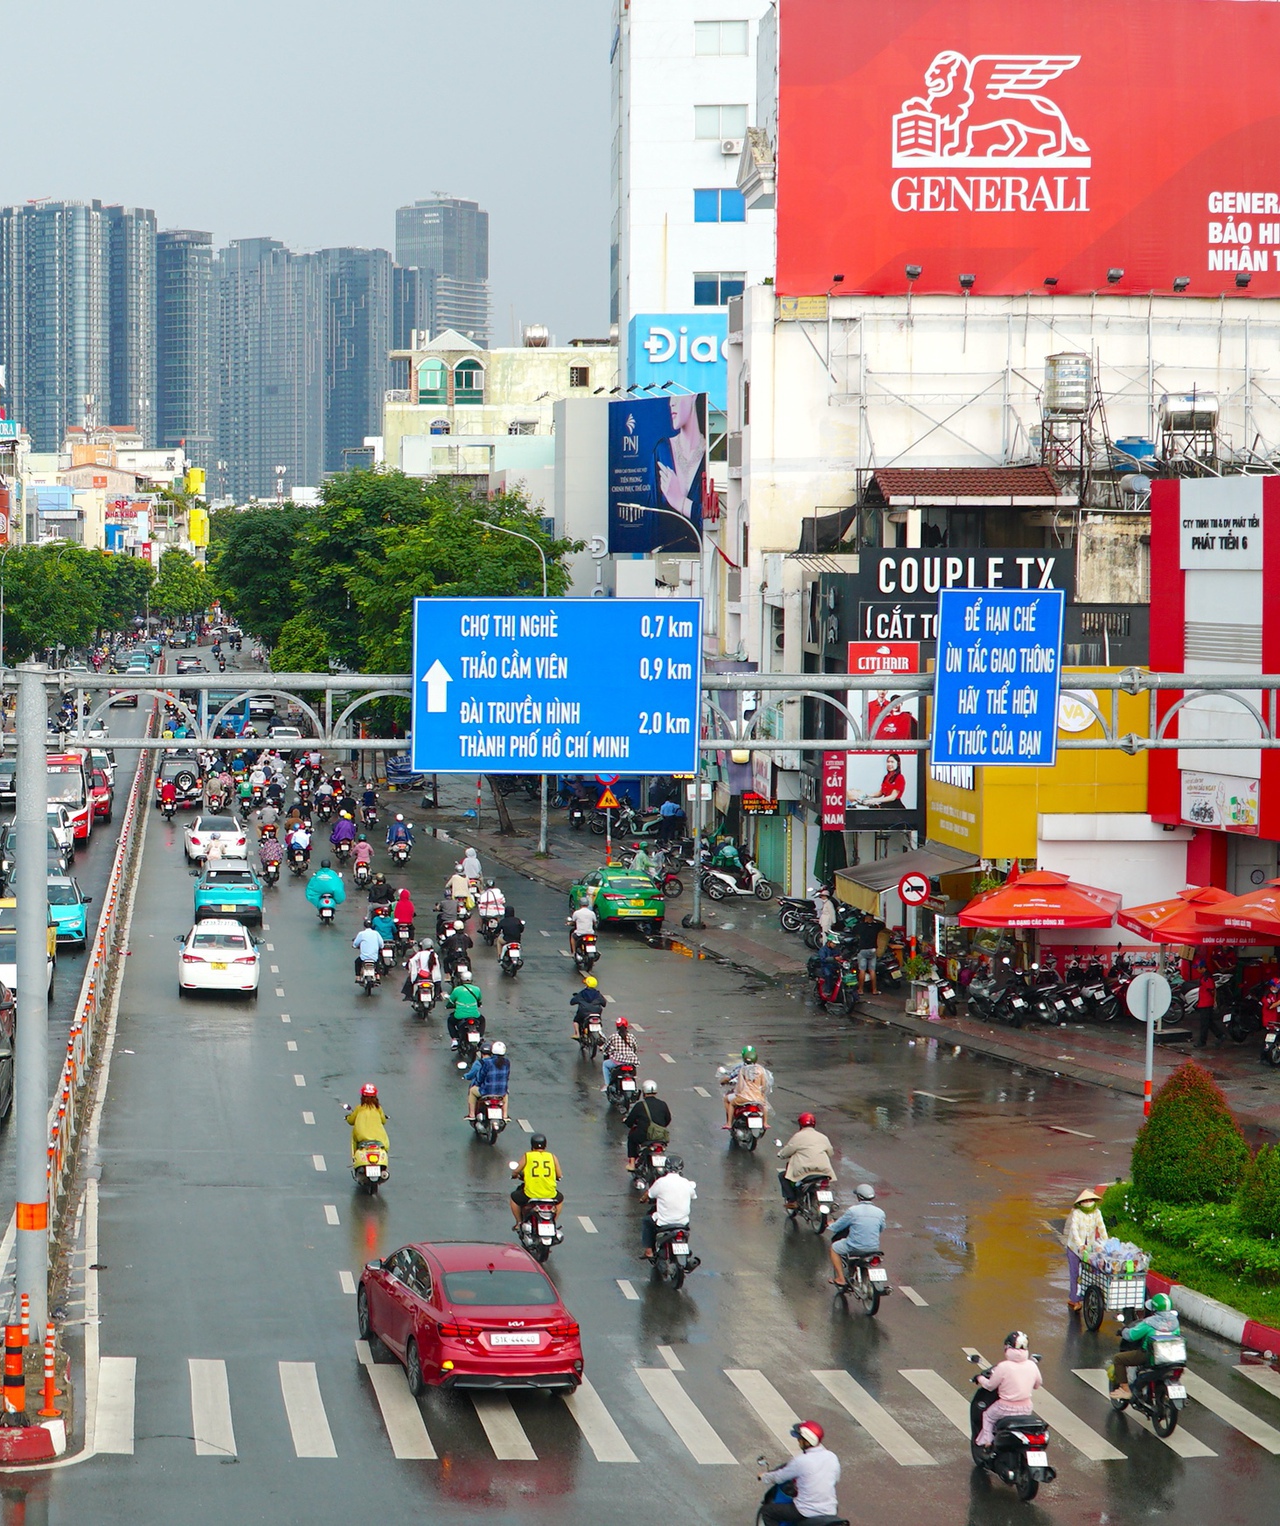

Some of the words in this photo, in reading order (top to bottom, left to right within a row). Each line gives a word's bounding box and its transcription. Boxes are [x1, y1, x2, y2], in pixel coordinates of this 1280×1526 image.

[891, 176, 1091, 212] GENERALI
[1208, 191, 1280, 214] GENER
[1208, 215, 1252, 244] BẢO
[1208, 245, 1268, 271] NHÂN
[643, 326, 728, 363] Dia
[623, 435, 639, 454] PNJ
[115, 500, 128, 509] SP
[1192, 533, 1216, 549] PHÁT
[1242, 536, 1248, 549] 6
[878, 556, 1004, 593] COUPLE
[1015, 557, 1056, 589] TX
[461, 614, 491, 640] CHỢ
[493, 614, 516, 640] THỊ
[520, 610, 558, 638] NGHÈ
[641, 615, 664, 640] 0,7
[668, 615, 693, 638] km
[876, 605, 915, 638] CẮT
[965, 597, 983, 632] ĐỂ
[986, 606, 1010, 636] HẠN
[1013, 598, 1040, 632] CHẾ
[461, 651, 497, 679] THẢO
[501, 648, 531, 679] CẦM
[535, 653, 567, 679] VIÊN
[858, 656, 881, 670] CITI
[882, 656, 909, 670] HAIR
[946, 641, 961, 673] ÙN
[966, 638, 988, 673] TẮC
[990, 648, 1016, 673] GIAO
[1020, 643, 1054, 673] THÔNG
[639, 657, 663, 682] 0,9
[666, 658, 692, 680] km
[460, 696, 483, 724] ĐÀI
[487, 694, 542, 724] TRUYỀN
[546, 697, 580, 724] HÌNH
[958, 685, 980, 714] HÃY
[986, 680, 1010, 714] THỂ
[1012, 685, 1037, 718] HIỆN
[1062, 704, 1085, 719] VA
[638, 711, 662, 735] 2,0
[665, 712, 690, 734] km
[459, 730, 505, 757] THÀNH
[510, 728, 541, 757] PHỐ
[542, 728, 561, 757] HỒ
[565, 731, 591, 757] CHÍ
[593, 736, 629, 758] MINH
[947, 724, 956, 755] Ý
[958, 724, 988, 755] THỨC
[992, 723, 1014, 755] CỦA
[1018, 730, 1041, 759] BẠN
[826, 771, 842, 788] CẮT
[826, 794, 842, 806] TÓC
[824, 813, 844, 824] NAM
[532, 1161, 551, 1177] 25
